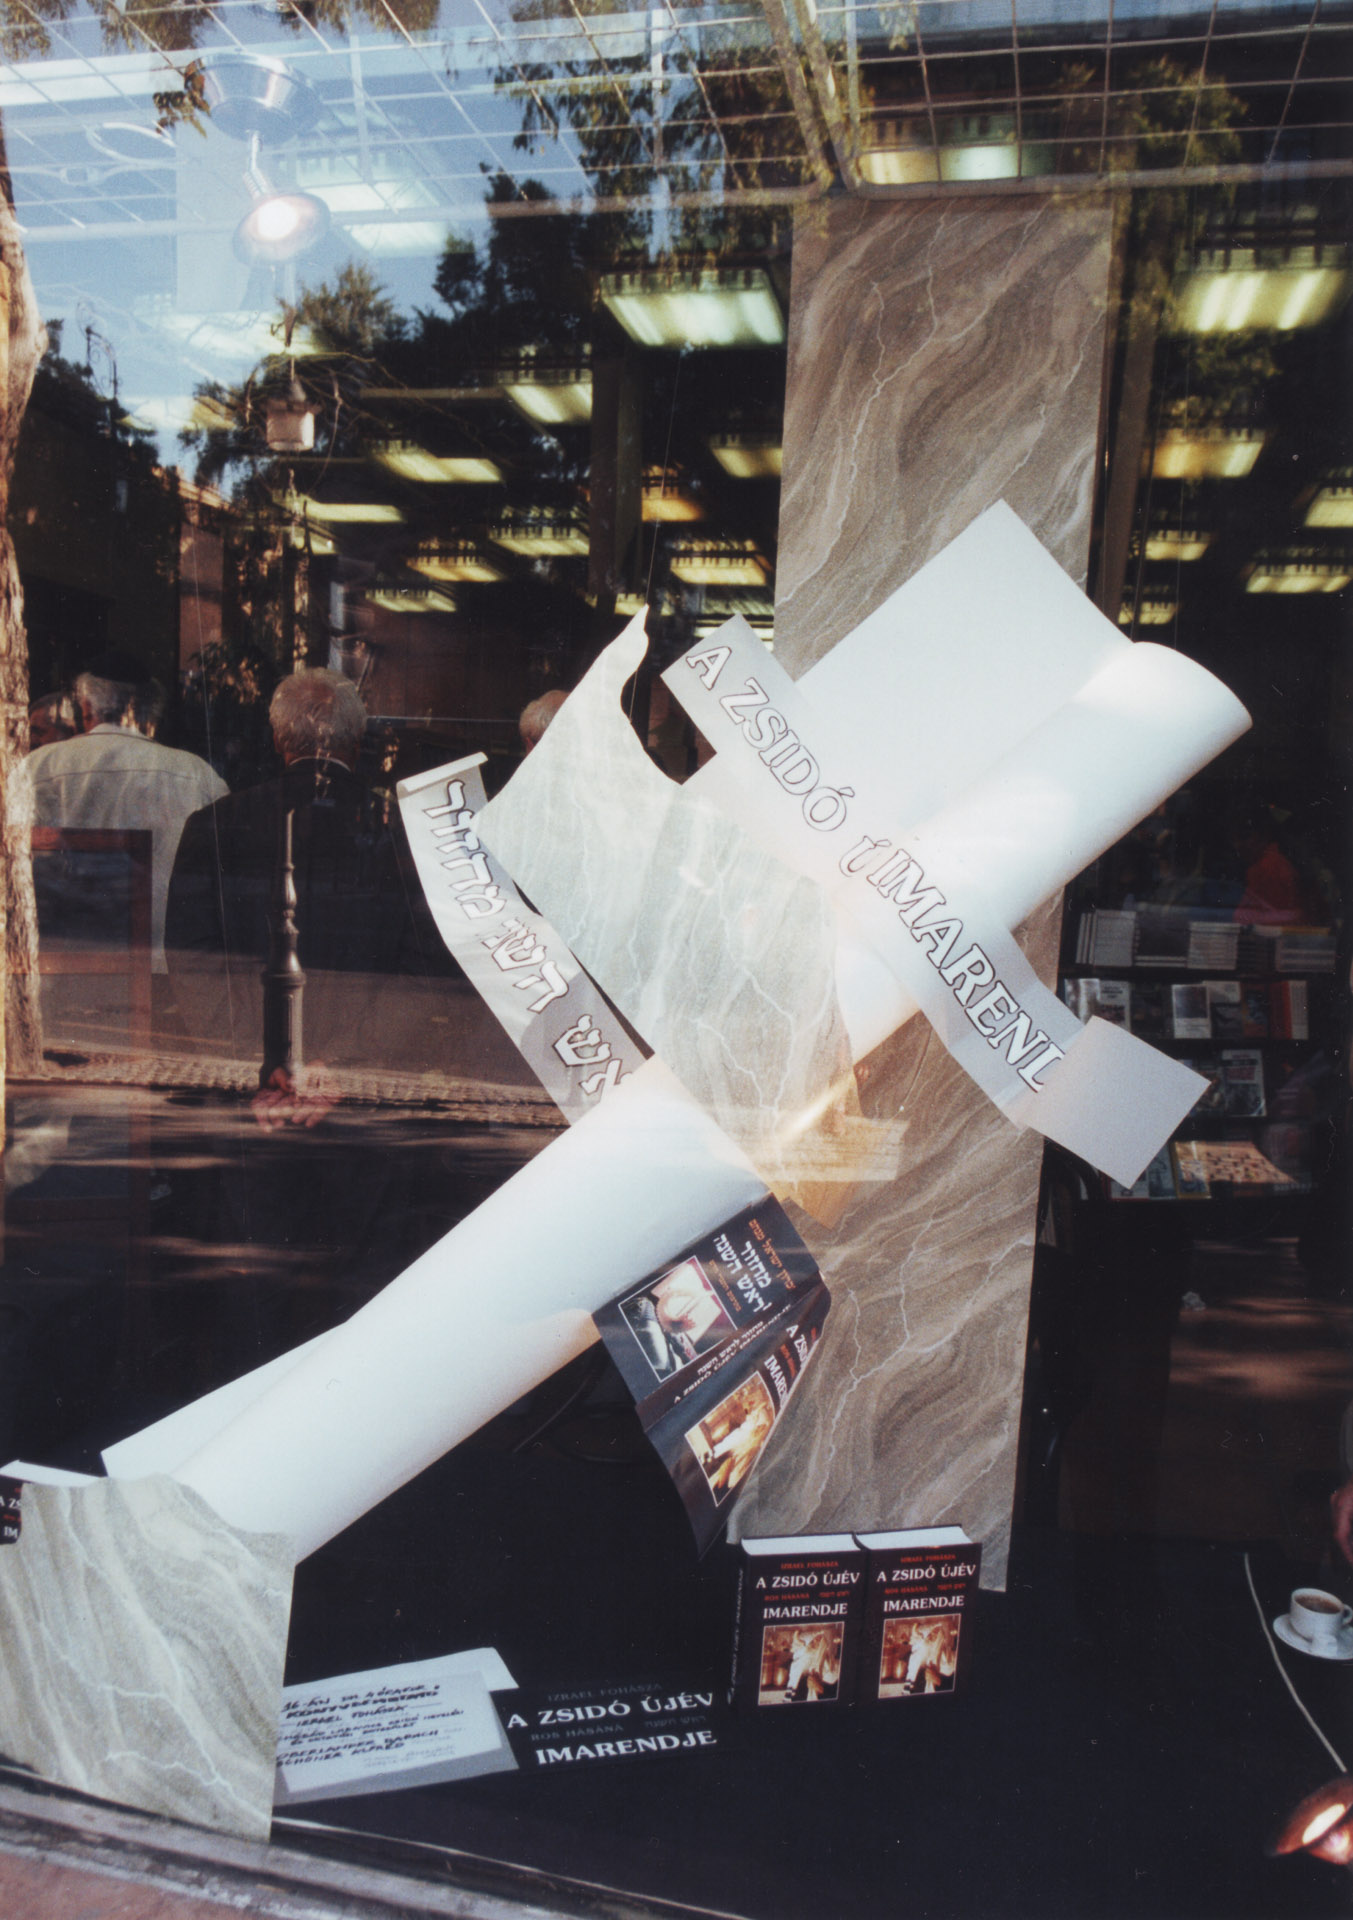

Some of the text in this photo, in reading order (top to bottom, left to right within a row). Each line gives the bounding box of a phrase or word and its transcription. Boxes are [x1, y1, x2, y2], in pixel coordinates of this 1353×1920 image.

[686, 645, 732, 690] A
[719, 677, 856, 832] ZSIDÓ
[421, 779, 508, 921] מחזור
[712, 1232, 744, 1275] השנה
[740, 1240, 773, 1290] מחזור
[785, 1323, 799, 1339] A
[756, 1569, 861, 1589] A ZSIDÓ ÚJÉV
[876, 1562, 977, 1583] A ZSIDÓ ÚJÉV
[762, 1602, 849, 1619] IMARENDJE
[883, 1594, 965, 1613] IMARENDJE
[507, 1691, 714, 1729] A ZSIDÓ ÚJÉV
[535, 1730, 718, 1766] IMARENDJE
